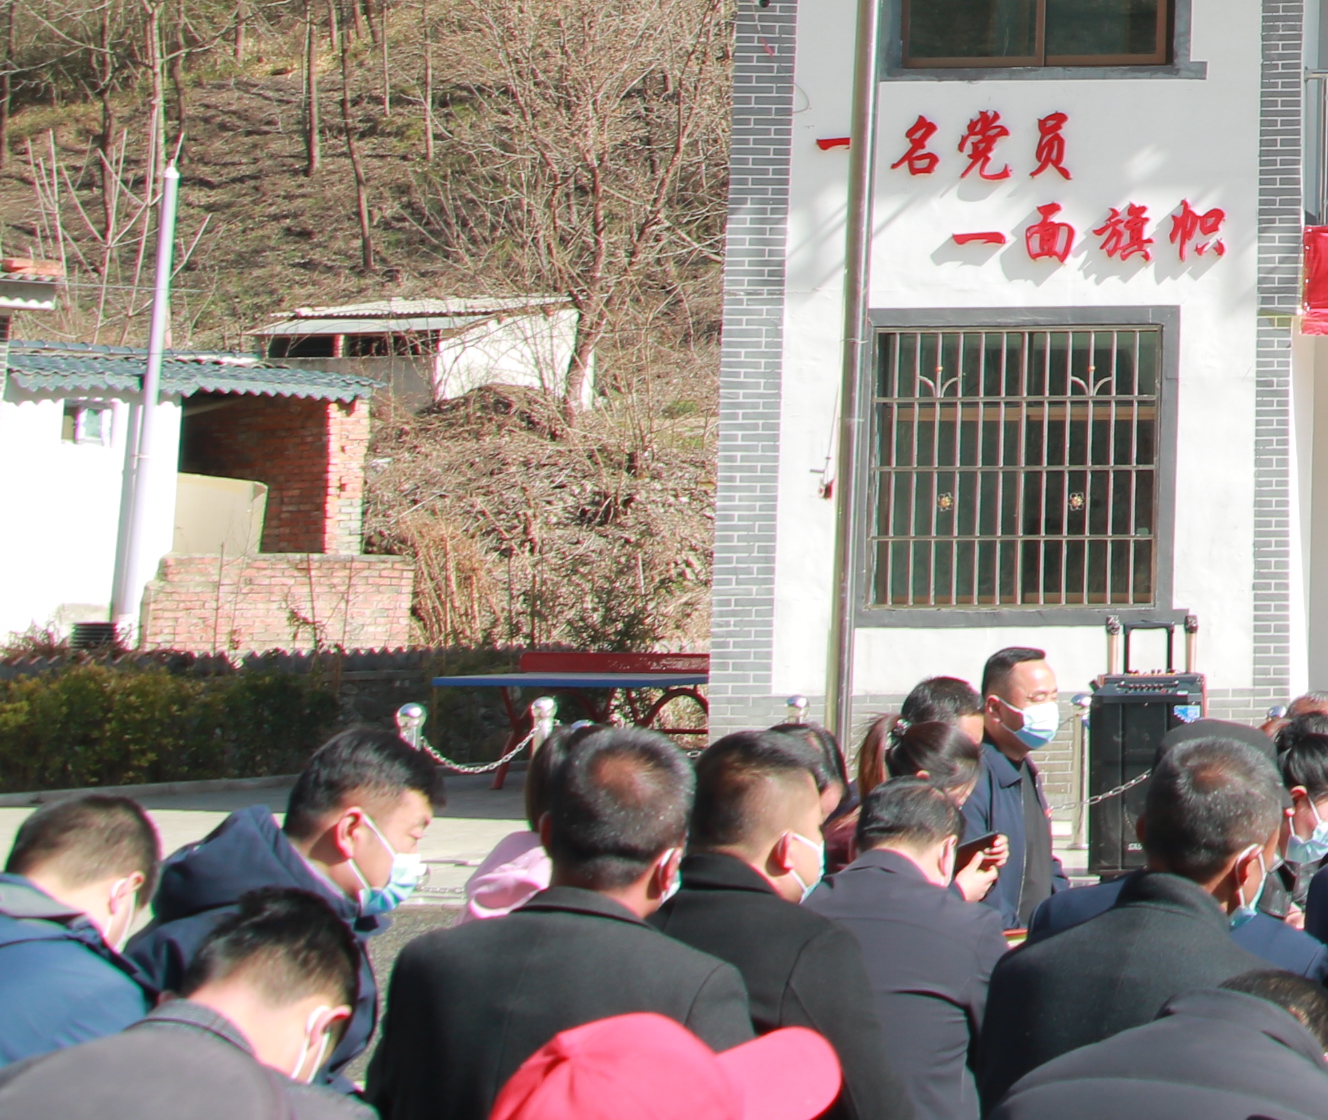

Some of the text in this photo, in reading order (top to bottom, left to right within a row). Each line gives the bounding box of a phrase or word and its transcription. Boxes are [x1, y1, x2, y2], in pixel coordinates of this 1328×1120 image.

[815, 110, 1073, 181] 一名党员
[951, 198, 1227, 263] 一面旗帜
